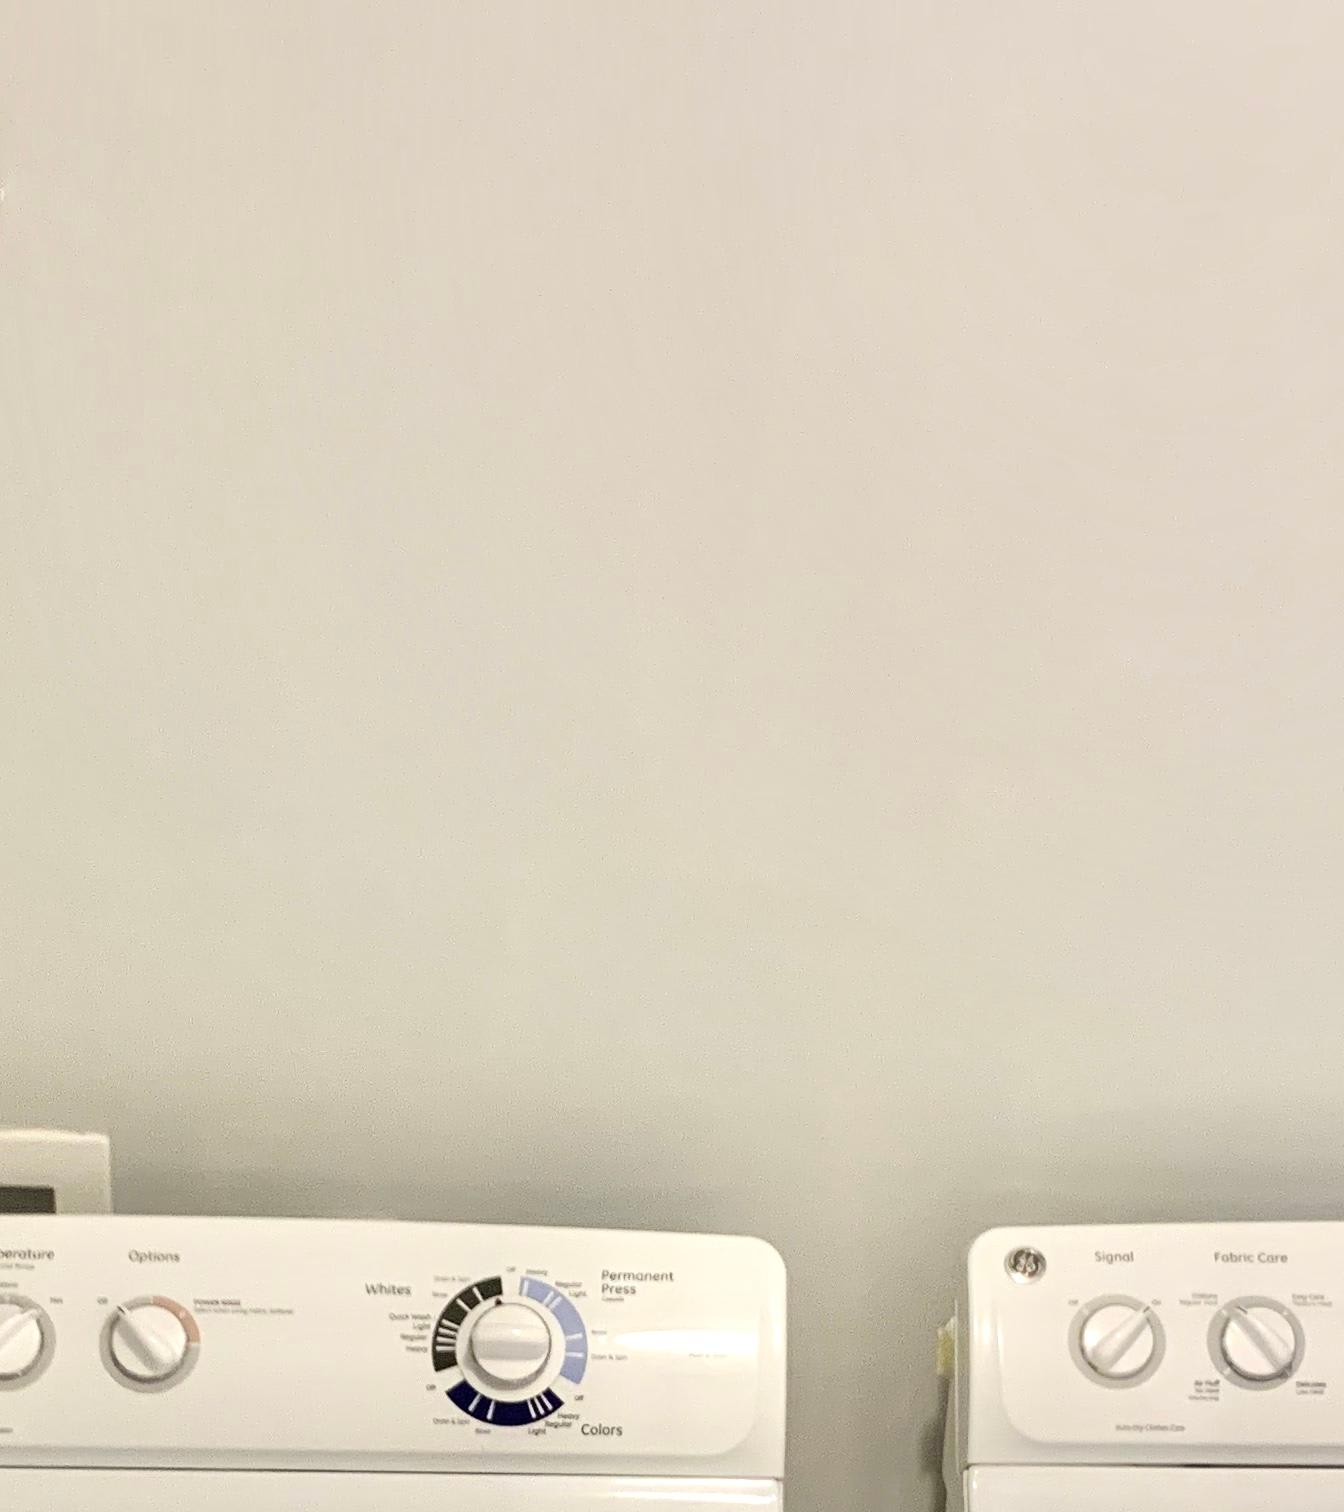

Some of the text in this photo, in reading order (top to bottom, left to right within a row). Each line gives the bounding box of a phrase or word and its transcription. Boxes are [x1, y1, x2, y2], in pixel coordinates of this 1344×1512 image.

[128, 1249, 181, 1264] Options
[1094, 1251, 1135, 1265] Signal
[1214, 1252, 1289, 1264] Fabric Care
[601, 1269, 675, 1283] Permanent
[364, 1283, 412, 1296] Whites
[601, 1283, 637, 1295] Press
[528, 1427, 547, 1436] Light
[581, 1423, 623, 1437] Colors
